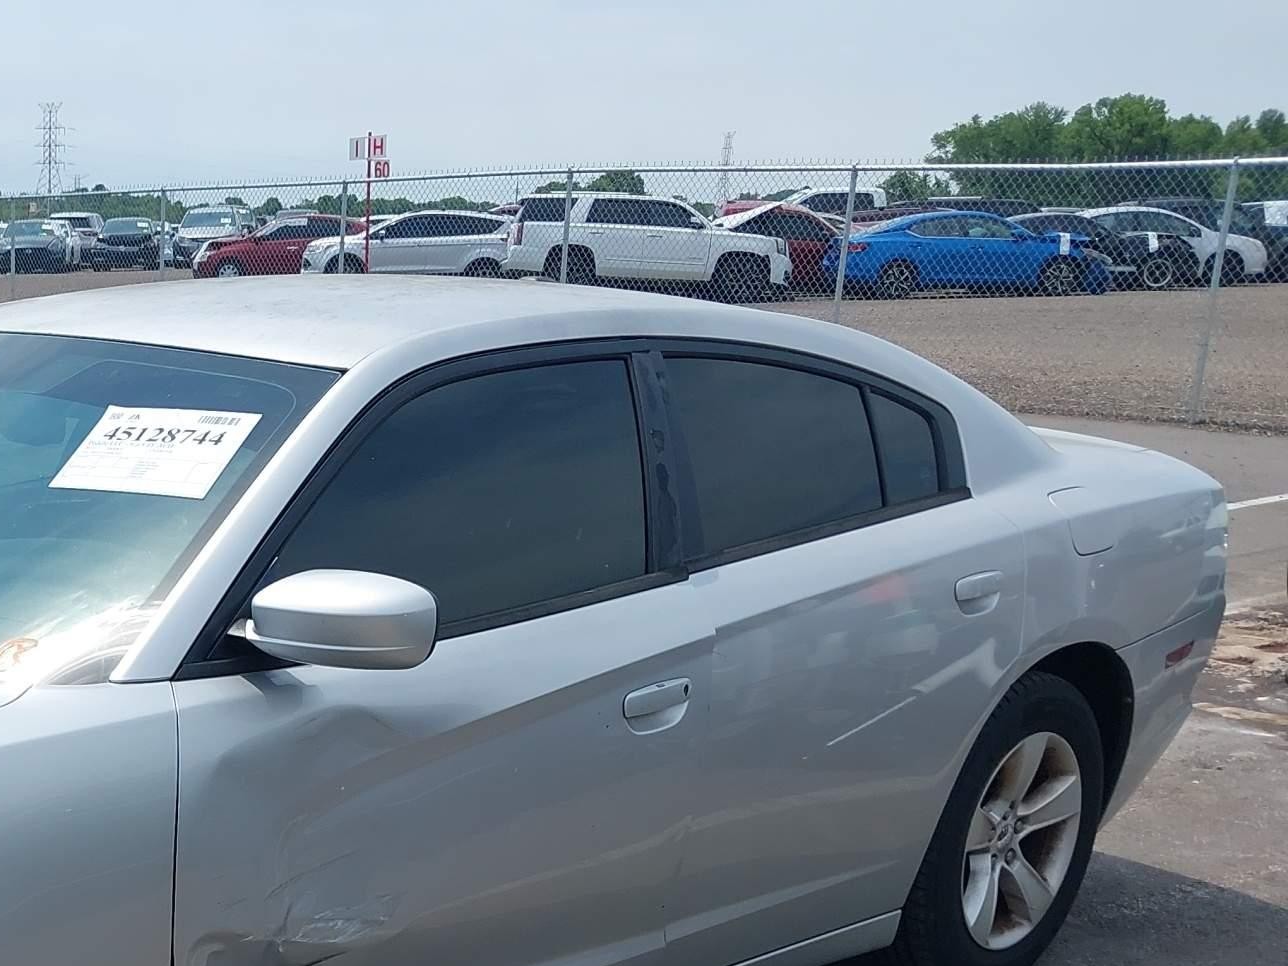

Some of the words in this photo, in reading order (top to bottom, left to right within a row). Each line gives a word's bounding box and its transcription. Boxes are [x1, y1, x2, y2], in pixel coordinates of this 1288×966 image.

[373, 137, 384, 156] H
[374, 161, 390, 178] 60
[103, 426, 228, 446] 45128744
